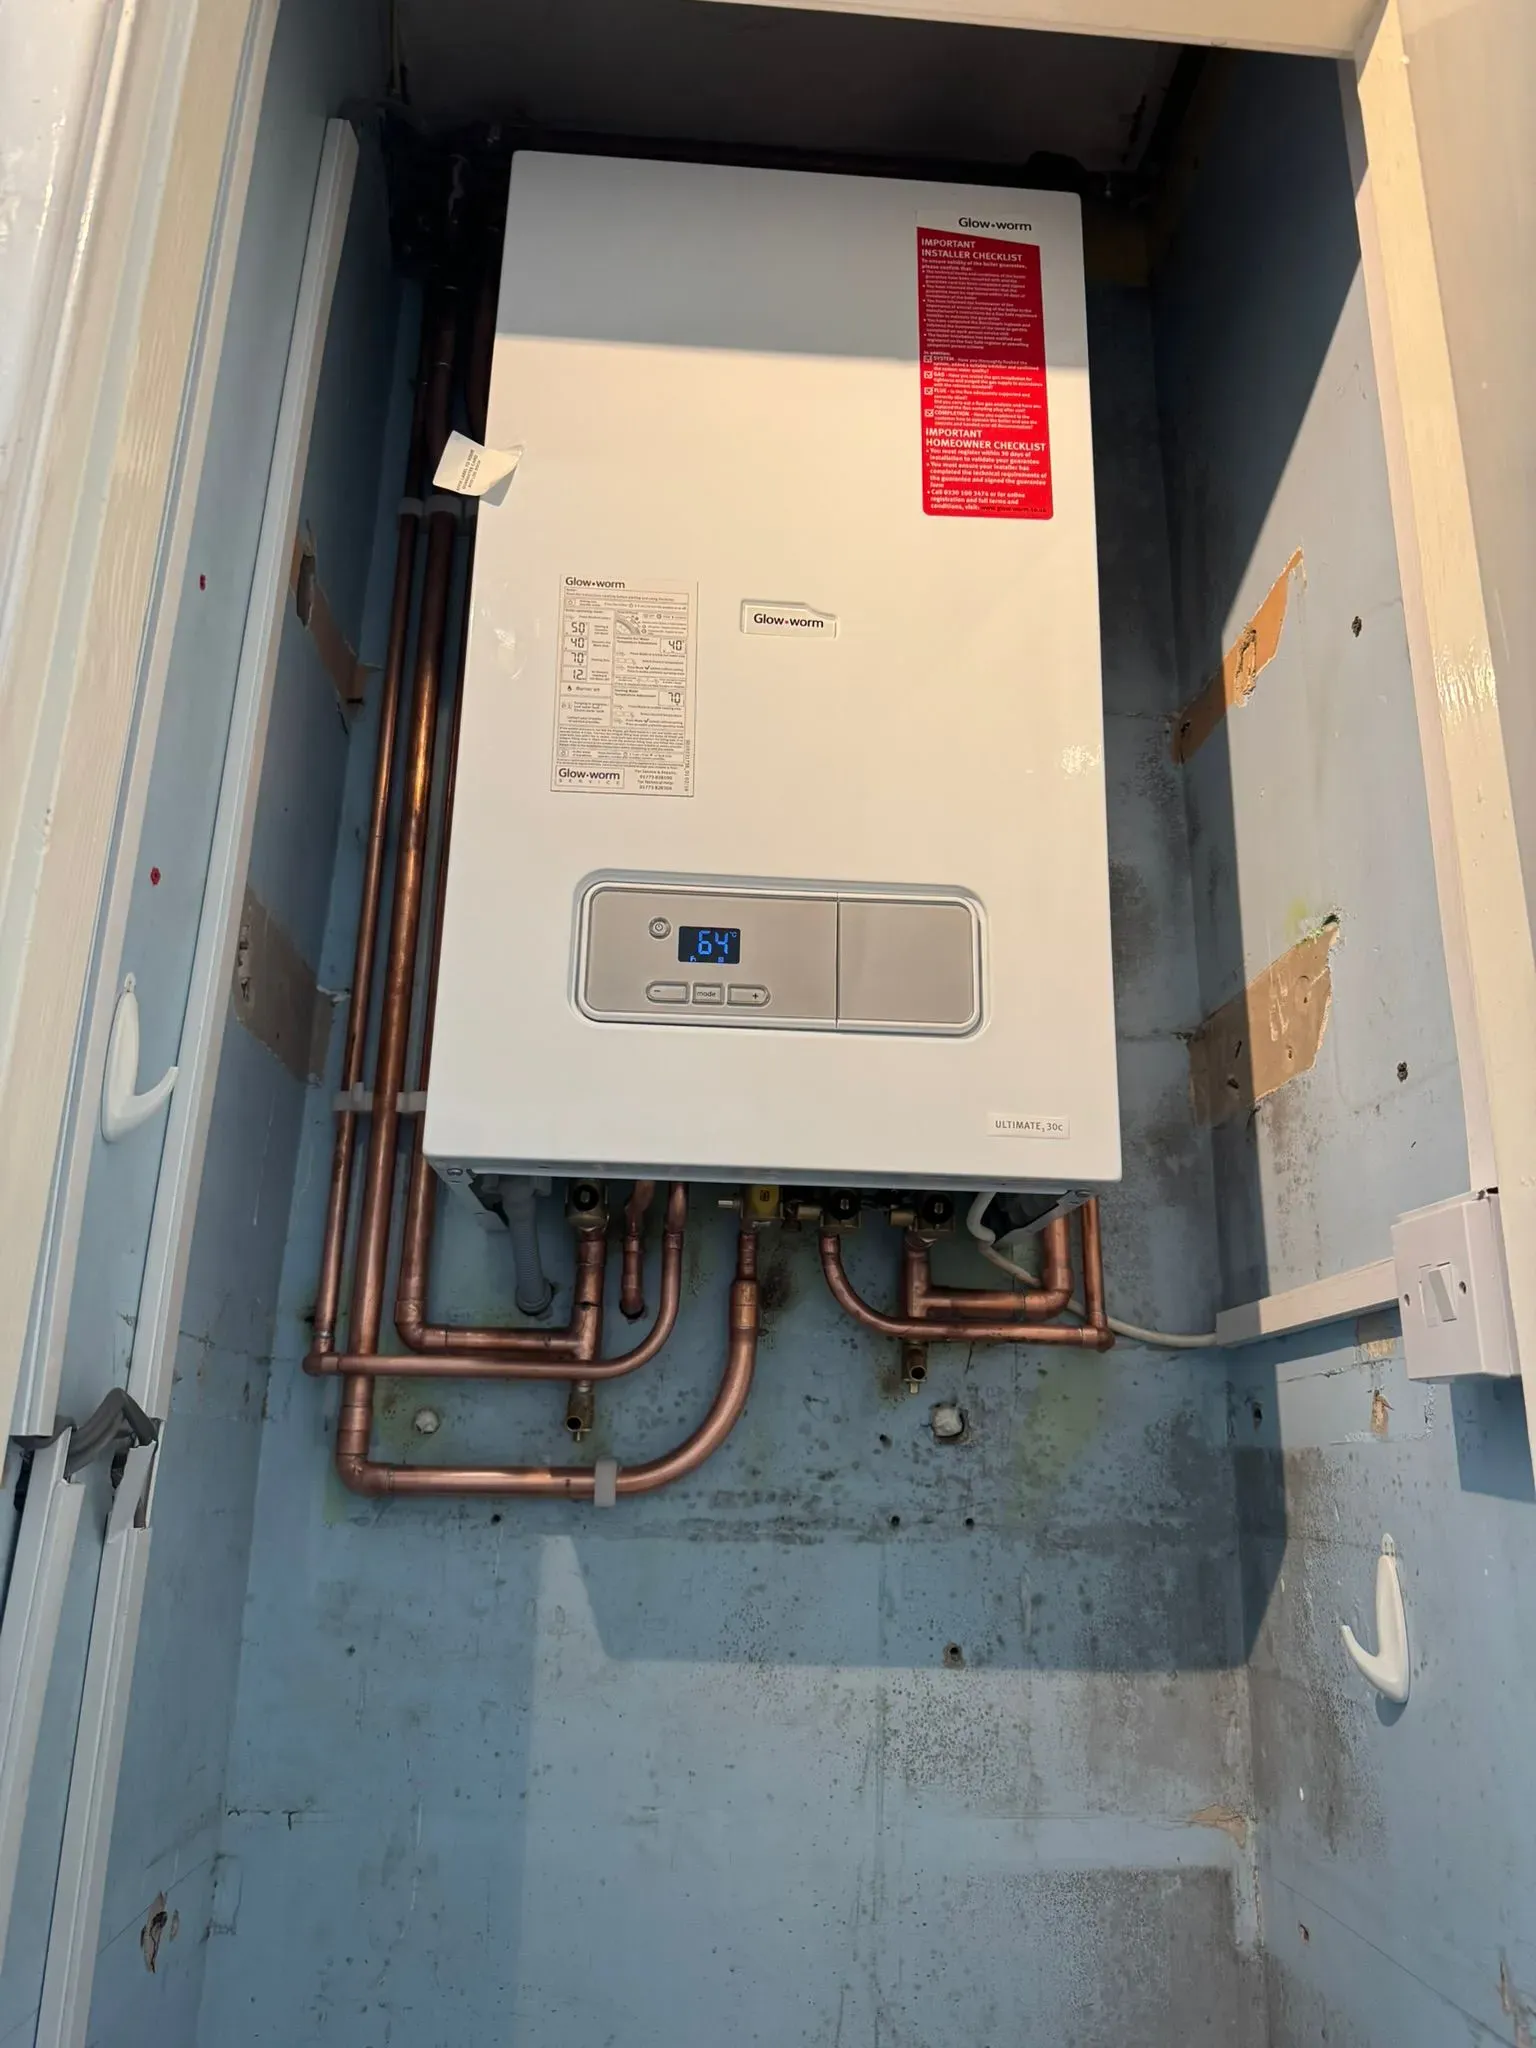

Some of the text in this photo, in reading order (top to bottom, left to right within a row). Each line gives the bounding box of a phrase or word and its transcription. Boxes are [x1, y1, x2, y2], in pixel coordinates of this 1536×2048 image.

[921, 238, 976, 248] IMPORTANT
[921, 249, 1022, 262] INSTALLER CHECKLIST
[926, 428, 982, 438] IMPORTANT
[926, 438, 1046, 451] HOMEOWNER CHECKLIST
[698, 930, 728, 955] 64
